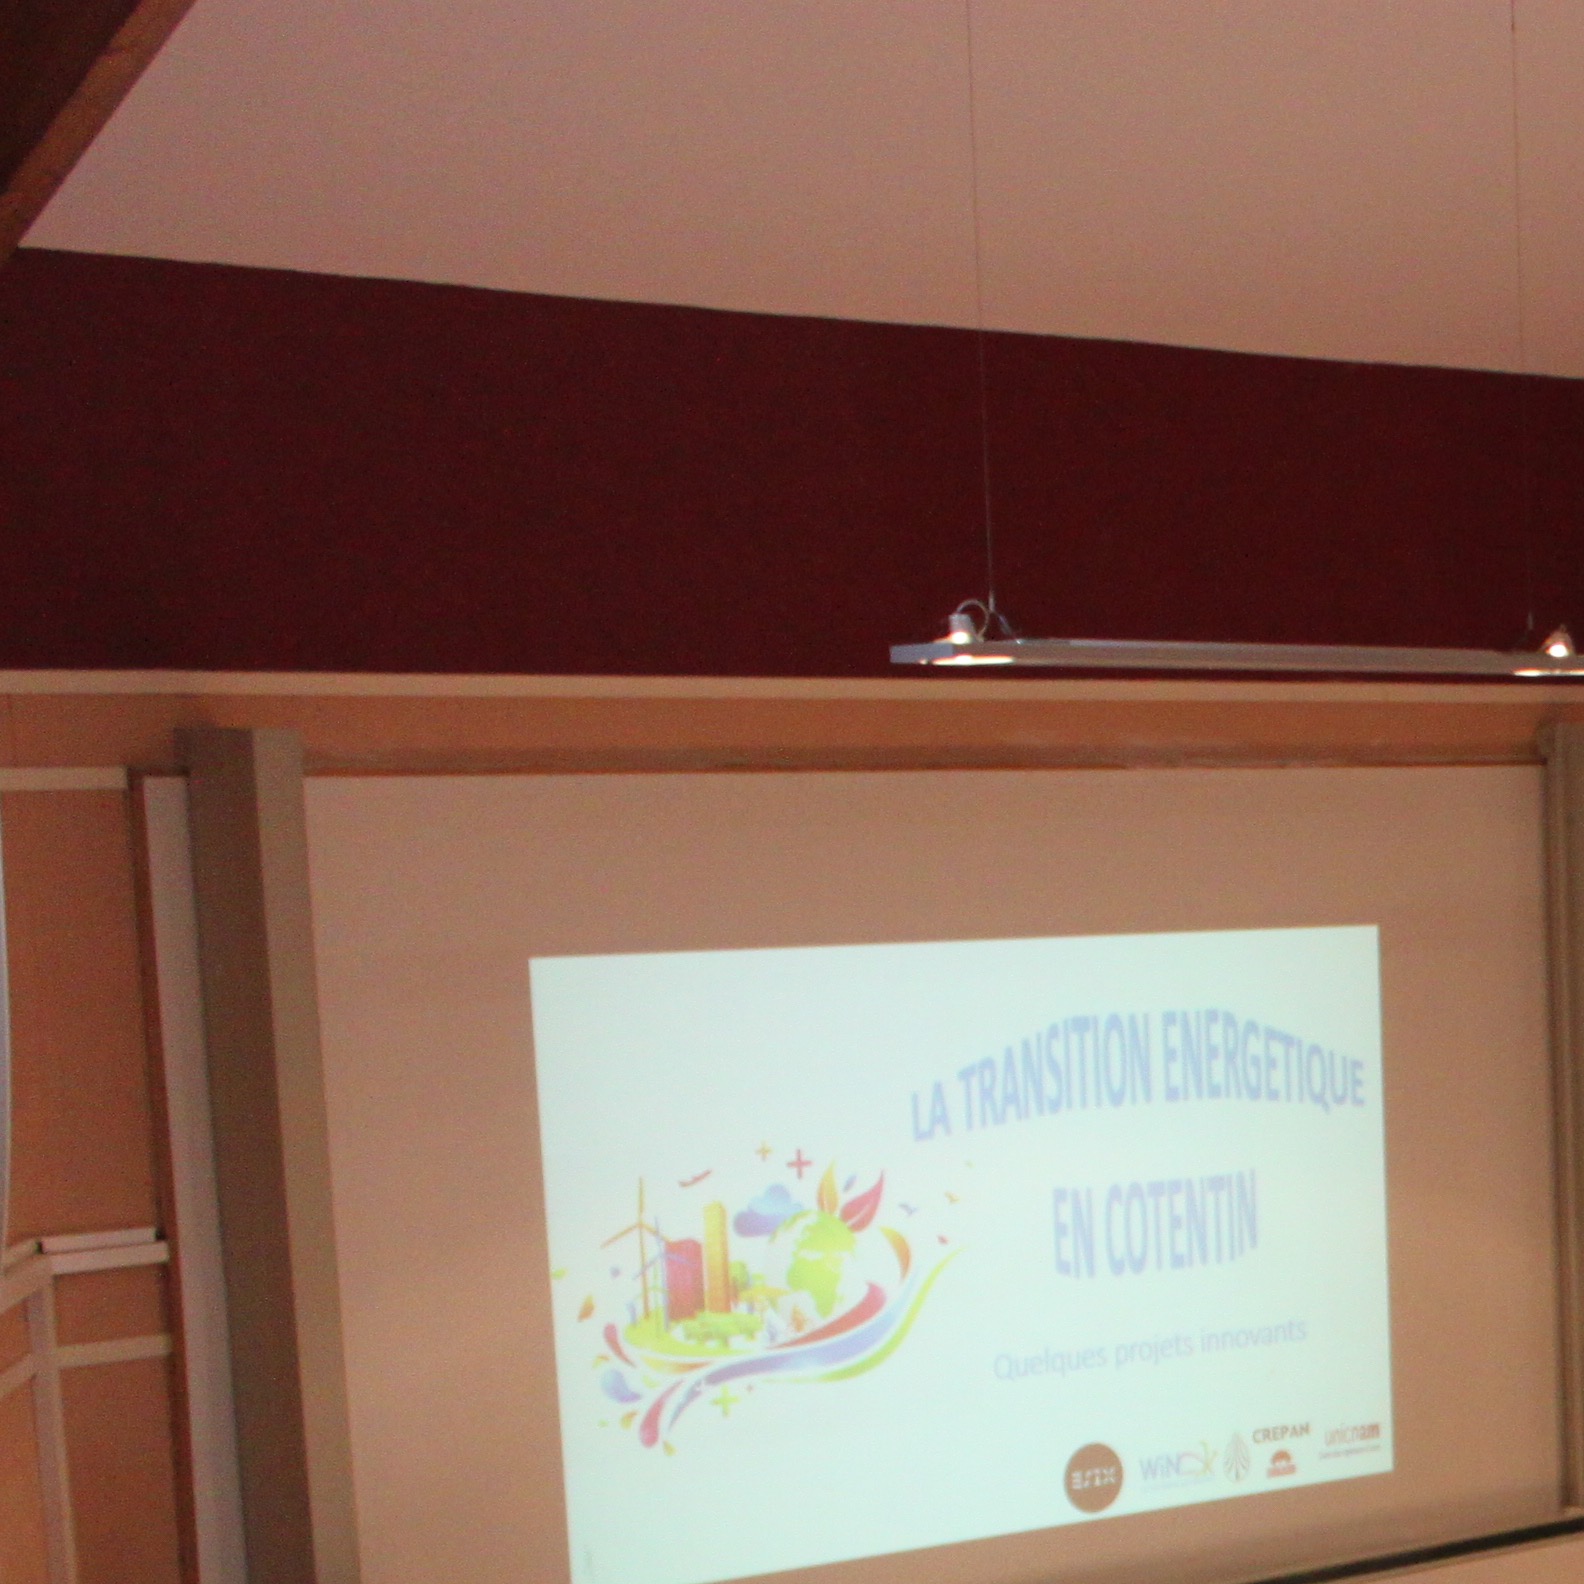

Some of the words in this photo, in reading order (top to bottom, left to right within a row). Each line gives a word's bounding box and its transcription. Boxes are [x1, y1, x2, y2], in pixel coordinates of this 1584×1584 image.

[911, 1080, 952, 1142] LA
[957, 1011, 1152, 1131] TRANSITION
[1162, 1008, 1366, 1115] ENERGETIQUE
[1053, 1186, 1096, 1279] EN
[1105, 1168, 1258, 1276] COTENTIN
[994, 1347, 1107, 1381] Quelques
[1115, 1333, 1194, 1371] projets
[1201, 1319, 1308, 1352] innovants
[1251, 1422, 1310, 1444] CREPAN
